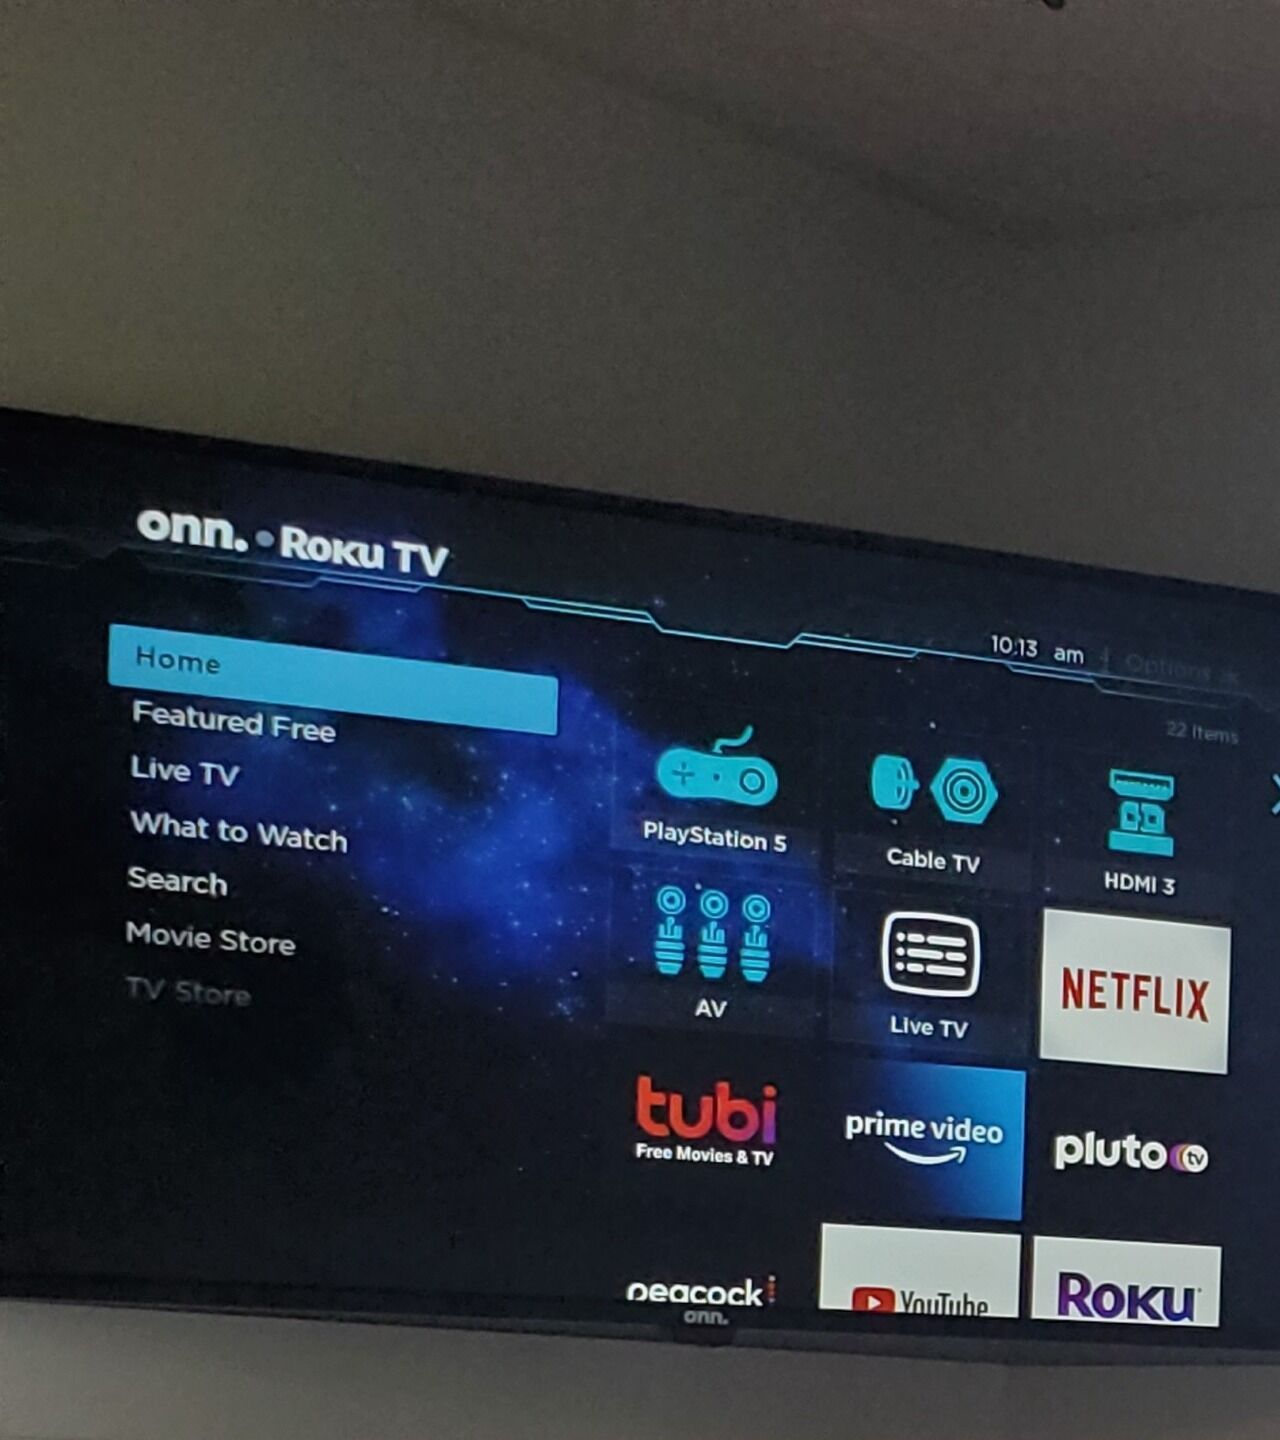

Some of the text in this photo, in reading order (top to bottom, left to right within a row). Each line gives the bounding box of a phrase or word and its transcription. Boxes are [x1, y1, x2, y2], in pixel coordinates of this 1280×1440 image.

[137, 509, 450, 577] onn. Roku TV
[135, 645, 221, 676] Home
[991, 634, 1085, 665] 10:13 am
[133, 700, 336, 744] Featured Free
[1166, 720, 1239, 745] 22 Items
[130, 755, 241, 787] Live TV
[130, 810, 348, 854] What to Watch
[643, 820, 788, 853] PlayStation 5
[886, 847, 981, 874] Cable TV
[127, 866, 228, 897] Search
[1104, 871, 1176, 896] HDMI 3
[126, 920, 297, 957] Movie Store
[125, 976, 252, 1007] TV Store
[1062, 966, 1210, 1023] NETFLIX
[695, 1000, 727, 1019] AV
[890, 1016, 969, 1040] Live TV
[637, 1075, 778, 1144] tubi
[845, 1111, 1004, 1146] prime video
[635, 1142, 774, 1167] Free Movies & TV
[1054, 1130, 1205, 1171] pluto tv
[1057, 1271, 1196, 1322] Roku
[683, 1309, 730, 1325] onn.
